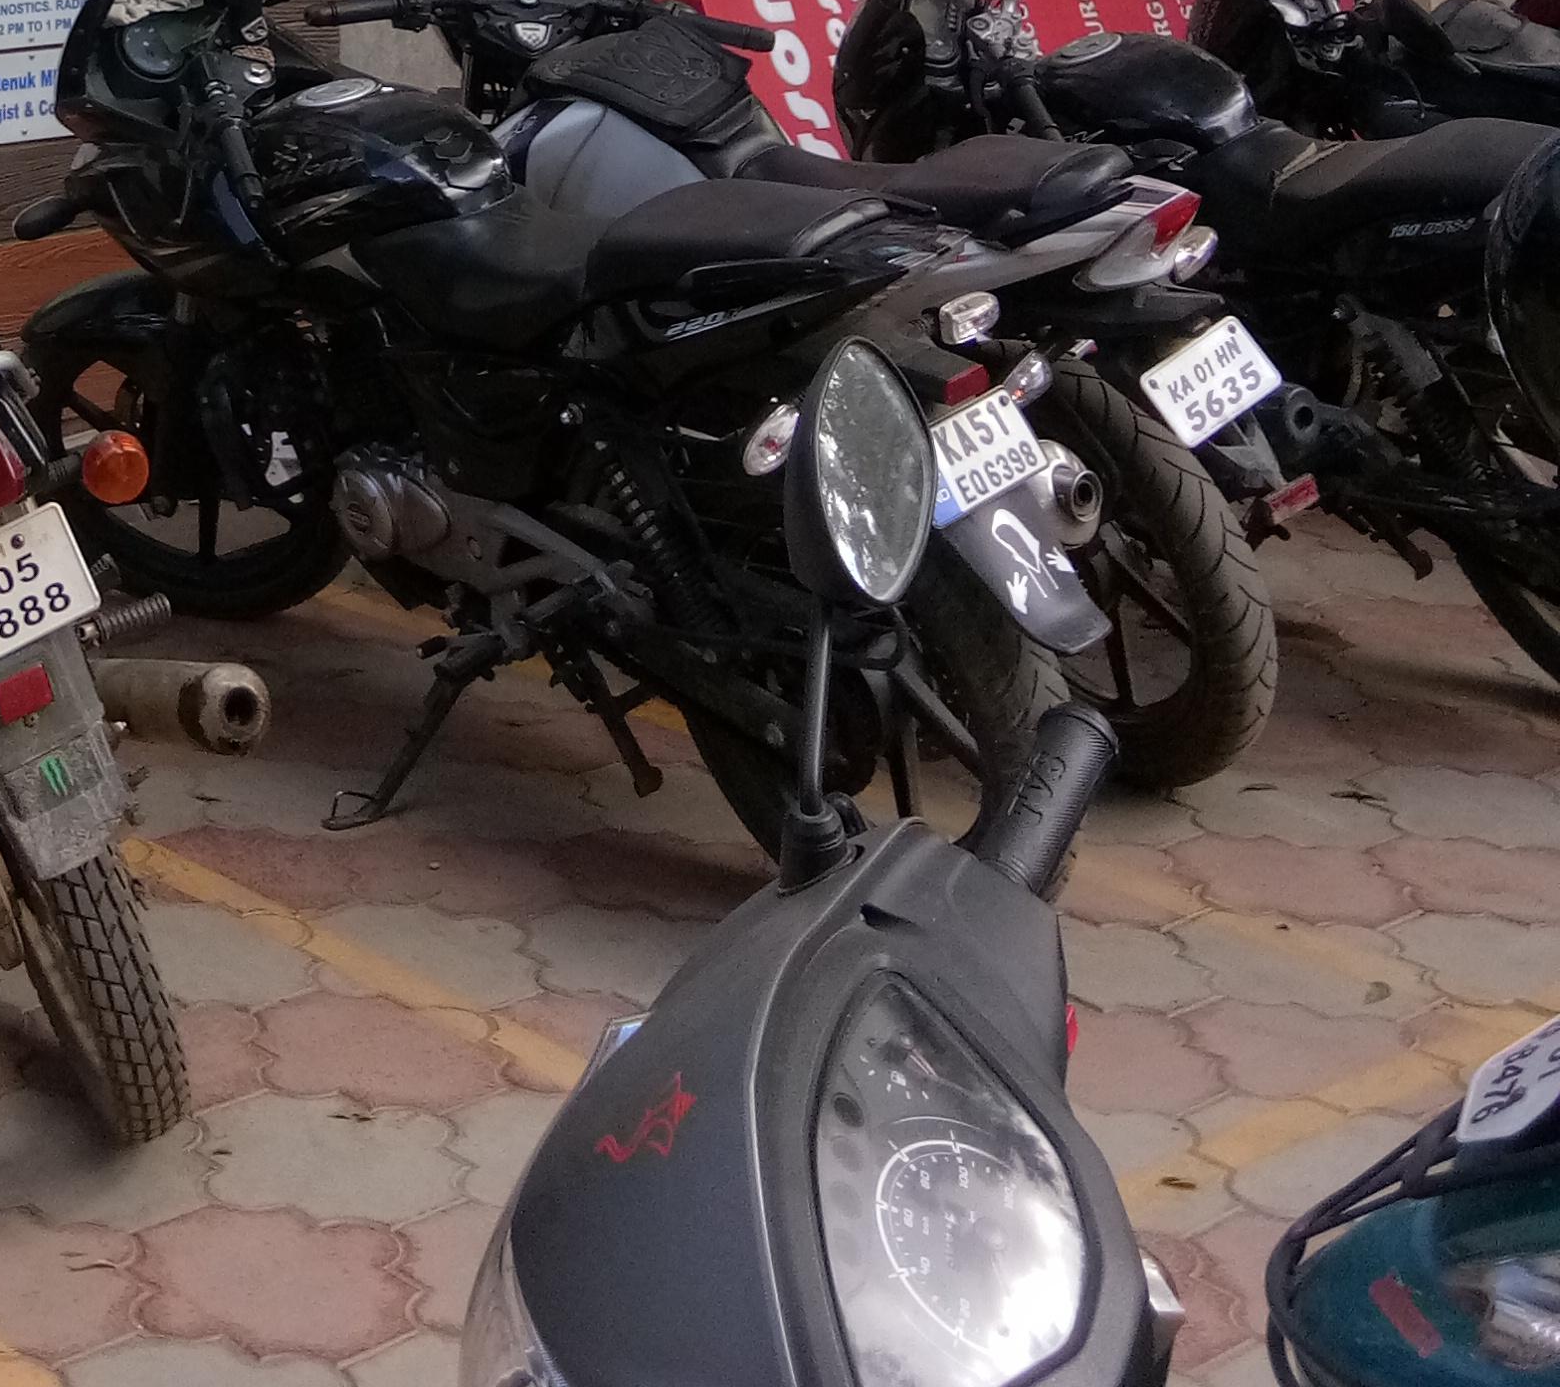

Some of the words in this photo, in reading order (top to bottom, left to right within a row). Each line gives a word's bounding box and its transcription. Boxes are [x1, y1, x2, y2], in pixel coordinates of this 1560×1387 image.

[8, 23, 24, 34] PM
[28, 21, 43, 32] TO
[46, 20, 51, 30] 1
[24, 101, 34, 117] &
[1167, 374, 1195, 404] KA
[1195, 357, 1215, 383] 01
[1214, 337, 1242, 368] HN
[1184, 361, 1263, 432] 5635
[933, 401, 1009, 466] KA51
